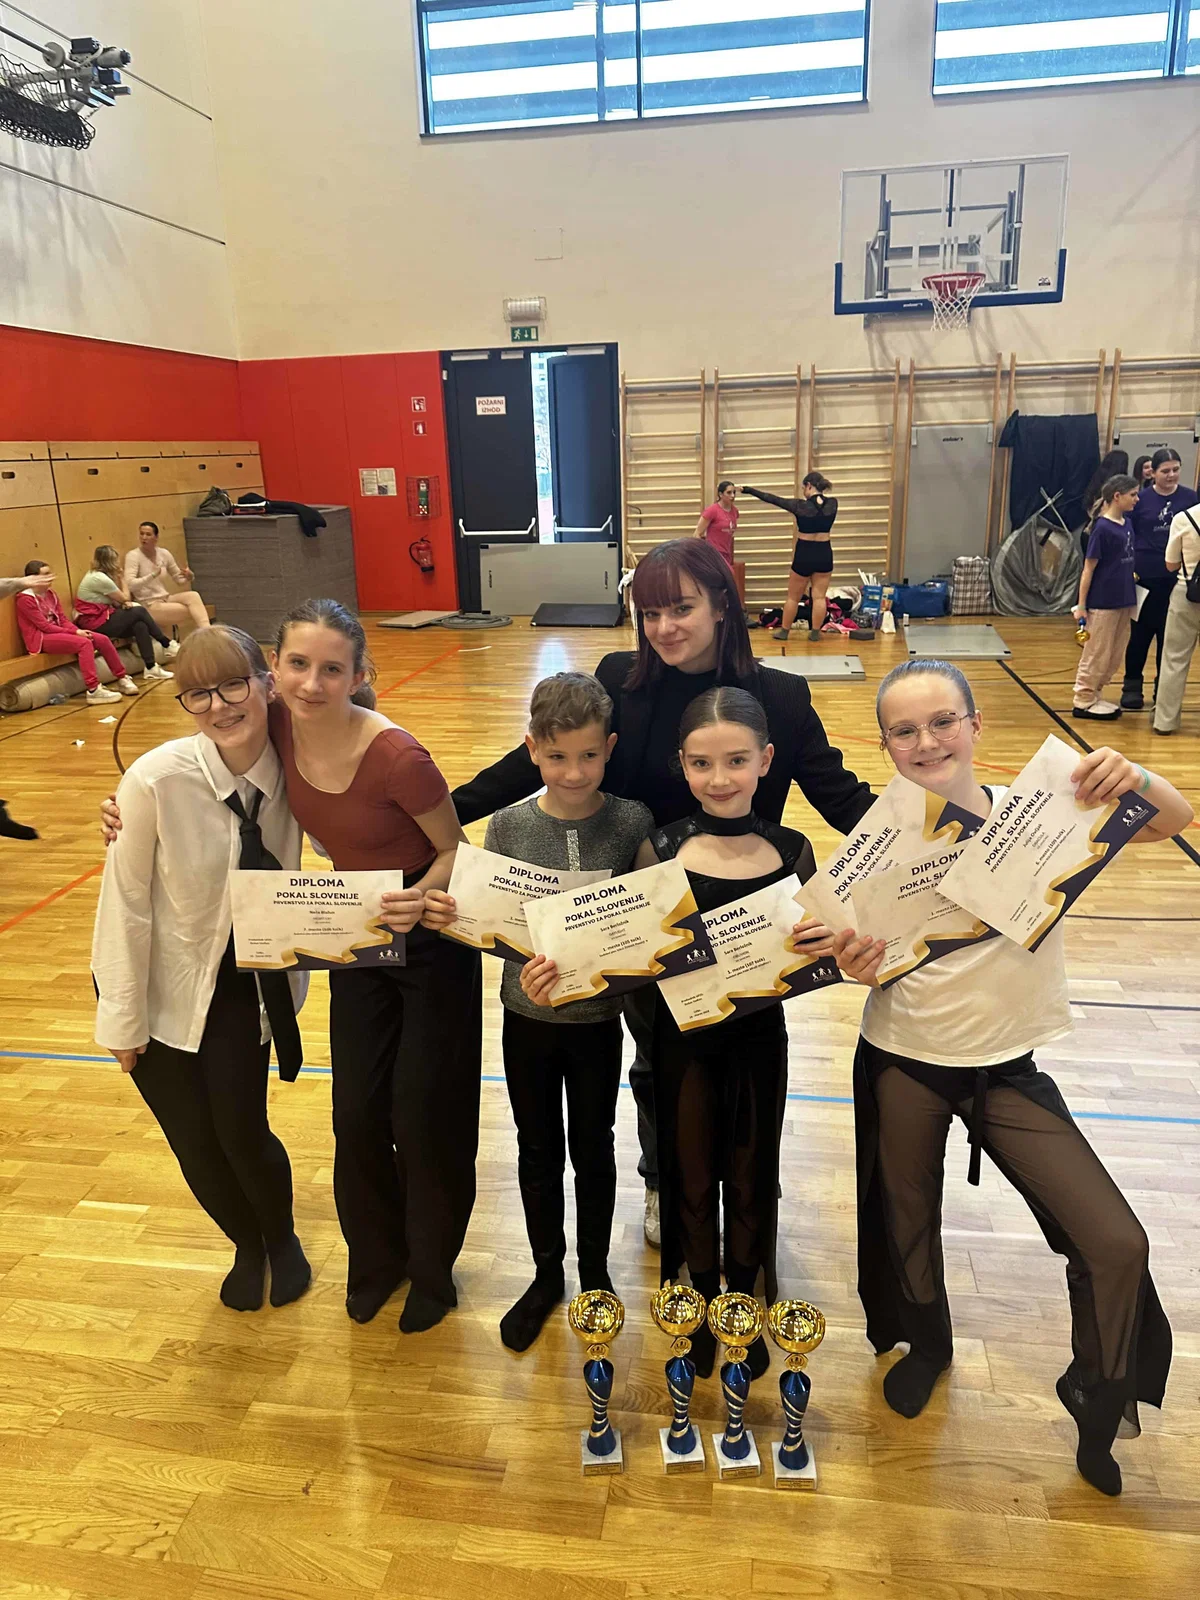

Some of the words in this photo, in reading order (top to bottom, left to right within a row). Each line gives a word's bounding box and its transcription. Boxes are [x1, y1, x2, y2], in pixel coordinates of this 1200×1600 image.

[981, 795, 1023, 846] DIPLOMA
[984, 837, 1009, 865] POKAL
[1006, 789, 1044, 836] SLOVENIJE
[990, 843, 1013, 873] PRVENSTVO
[1017, 819, 1032, 836] POKAL
[1030, 792, 1053, 819] SLOVENIJE
[828, 833, 871, 878] DIPLOMA
[867, 855, 882, 871] POKAL
[879, 828, 901, 855] SLOVENIJE
[834, 871, 859, 896] POKAL
[855, 826, 892, 871] SLOVENIJE
[290, 878, 344, 887] DIPLOMA
[493, 875, 522, 888] POKAL
[508, 865, 559, 884] DIPLOMA
[899, 876, 932, 892] POKAL
[488, 883, 518, 894] PRVENSTVO
[573, 884, 627, 906] DIPLOMA
[897, 885, 930, 900] PRVENSTVO
[564, 918, 596, 931] PRVENSTVO
[603, 910, 621, 919] POKAL
[622, 901, 650, 913] SLOVENIJE
[565, 909, 596, 923] POKAL
[596, 893, 645, 914] SLOVENIJE
[703, 907, 748, 929] IPLOMA
[718, 914, 766, 937] SLOVENIJE
[726, 933, 744, 942] POKAL
[744, 921, 772, 935] SLOVENIJE
